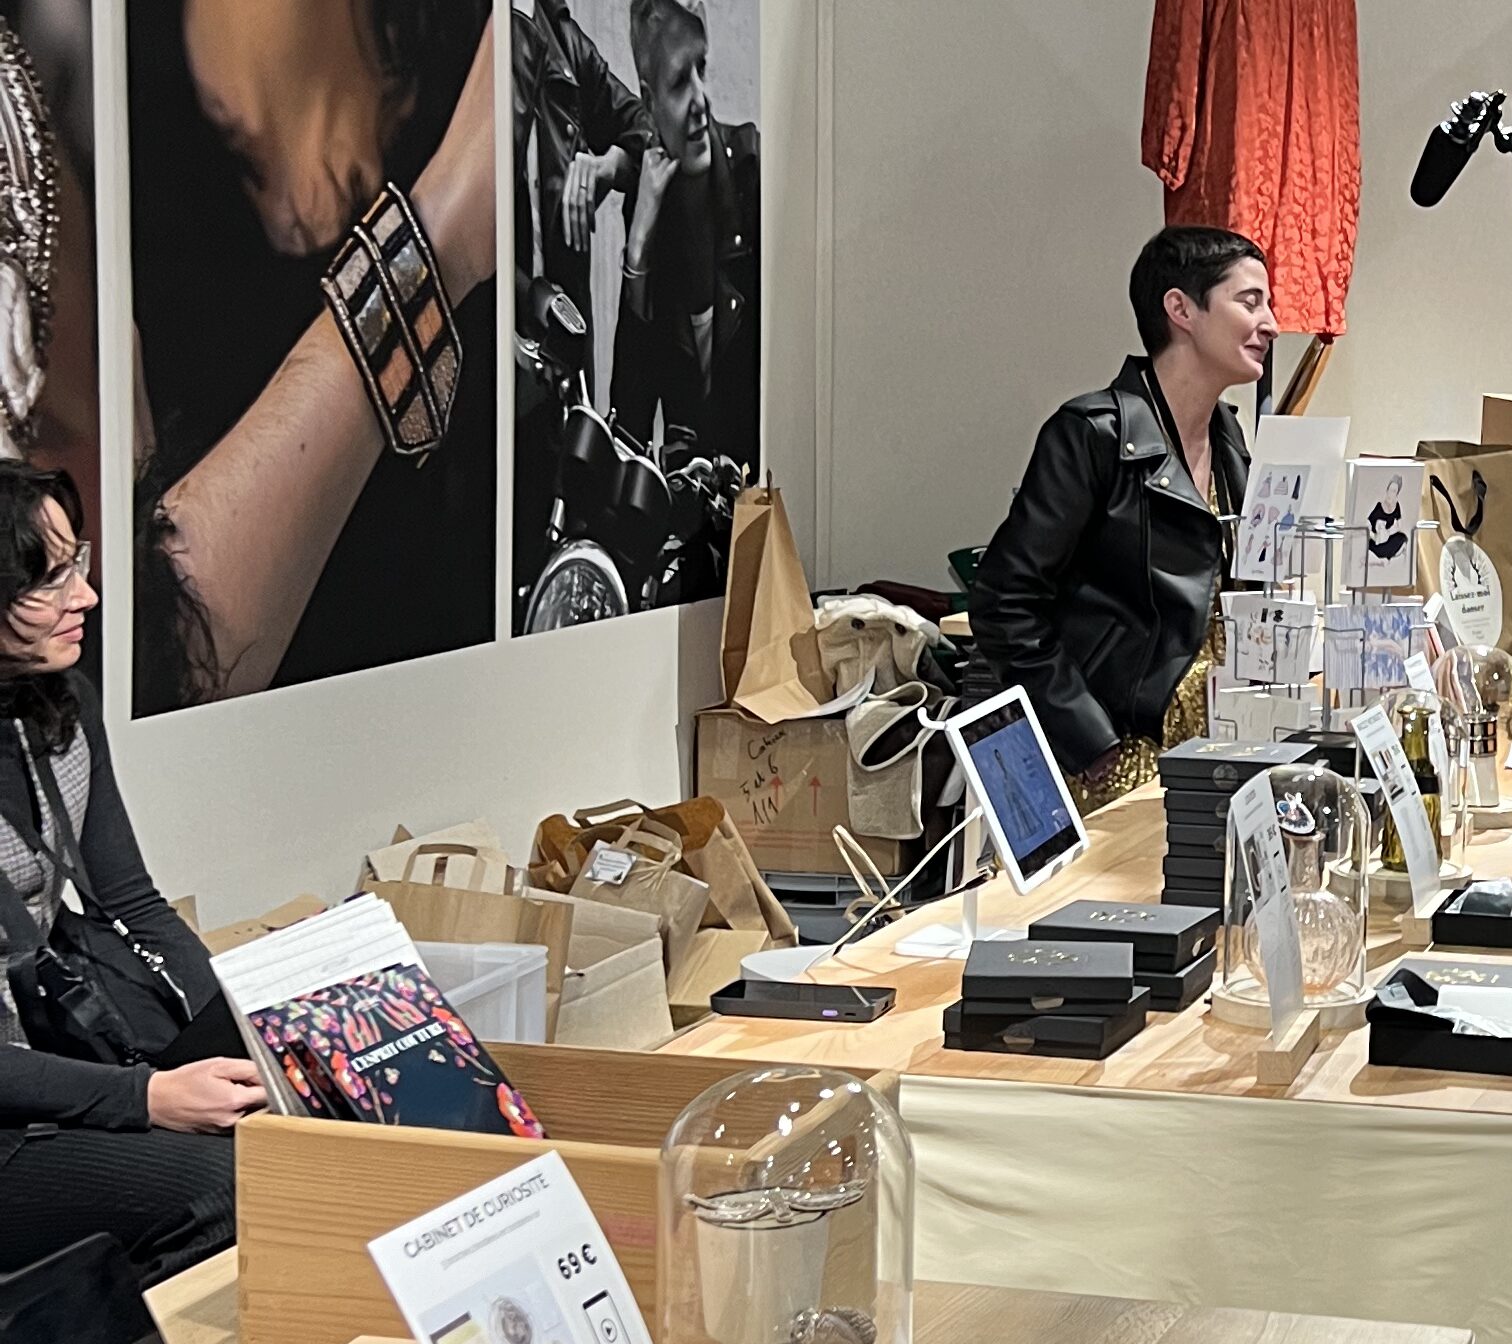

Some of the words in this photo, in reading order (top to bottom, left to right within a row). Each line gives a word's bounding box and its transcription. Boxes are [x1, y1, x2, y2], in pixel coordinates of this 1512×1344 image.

[403, 1217, 464, 1259] CABINET
[463, 1207, 486, 1229] DE
[557, 1252, 582, 1280] 69
[581, 1243, 598, 1266] €
